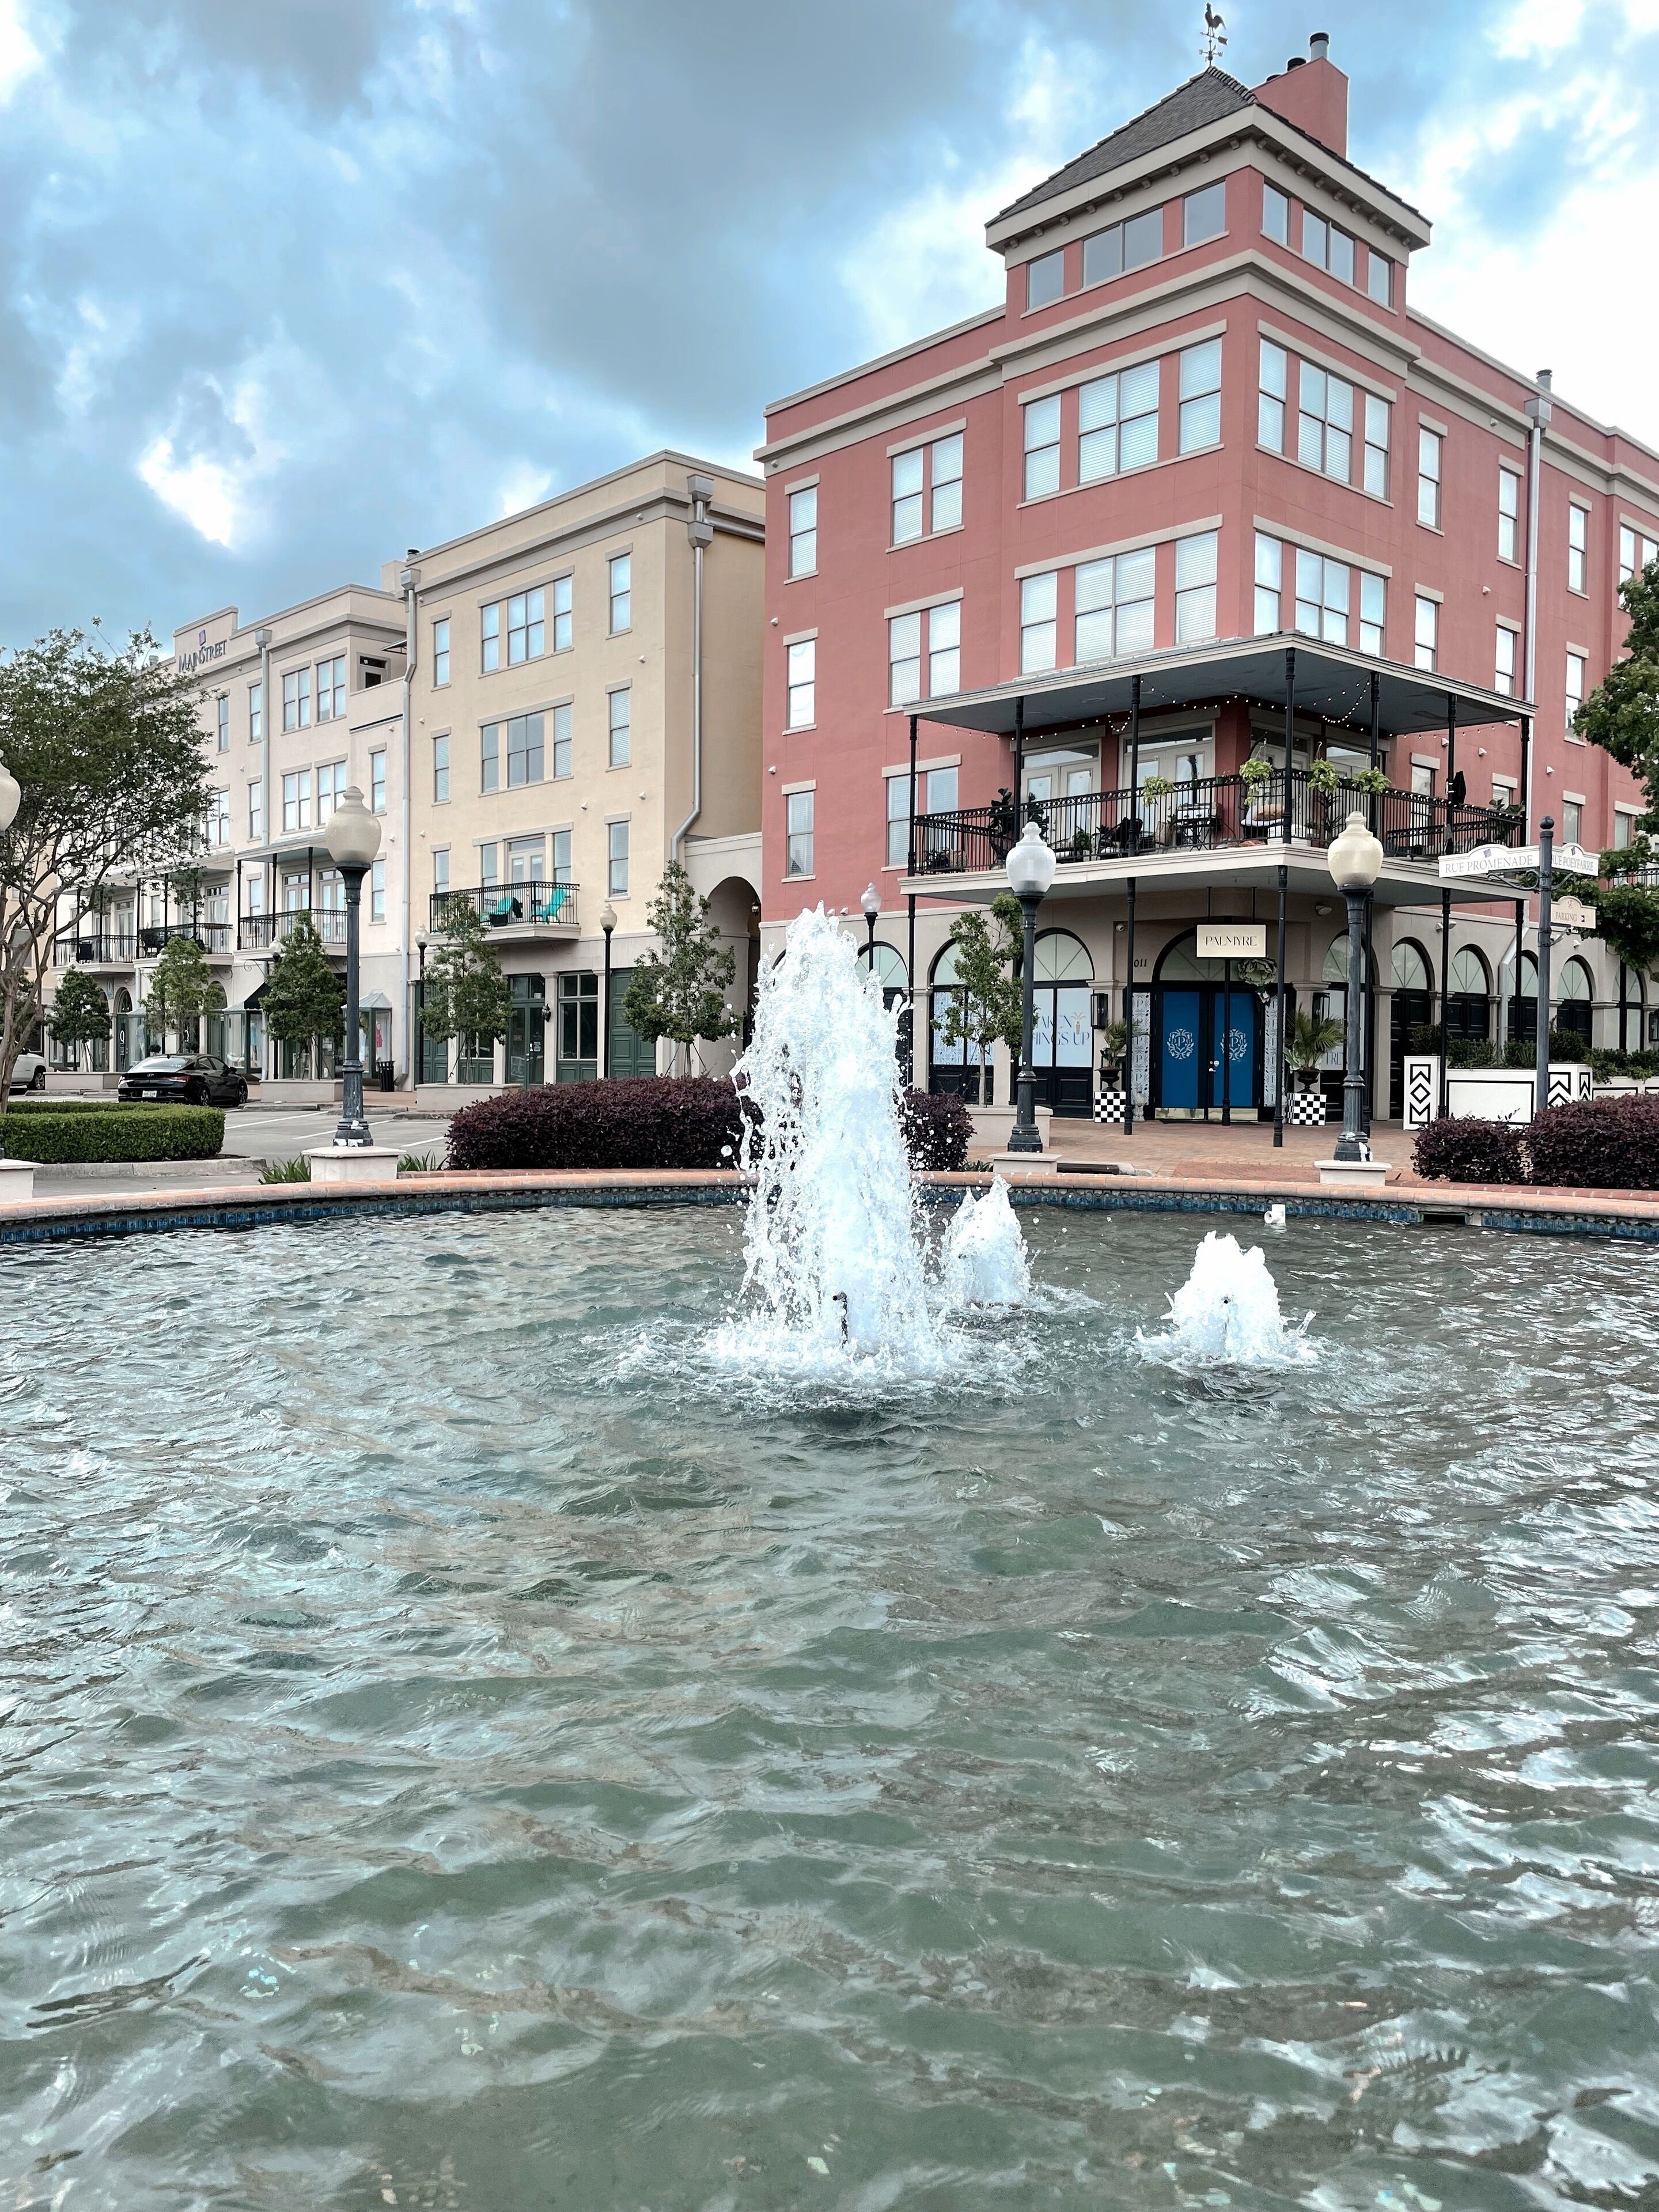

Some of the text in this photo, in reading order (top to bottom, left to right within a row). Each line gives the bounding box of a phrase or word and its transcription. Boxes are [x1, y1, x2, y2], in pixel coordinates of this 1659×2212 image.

[1445, 855, 1533, 873] RUE PROMENADE
[1552, 854, 1562, 866] RUE
[1555, 911, 1577, 922] PARKING
[1206, 936, 1257, 946] PALMYRE
[1073, 1032, 1090, 1046] UP
[1178, 1037, 1185, 1047] P
[1231, 1037, 1239, 1048] P
